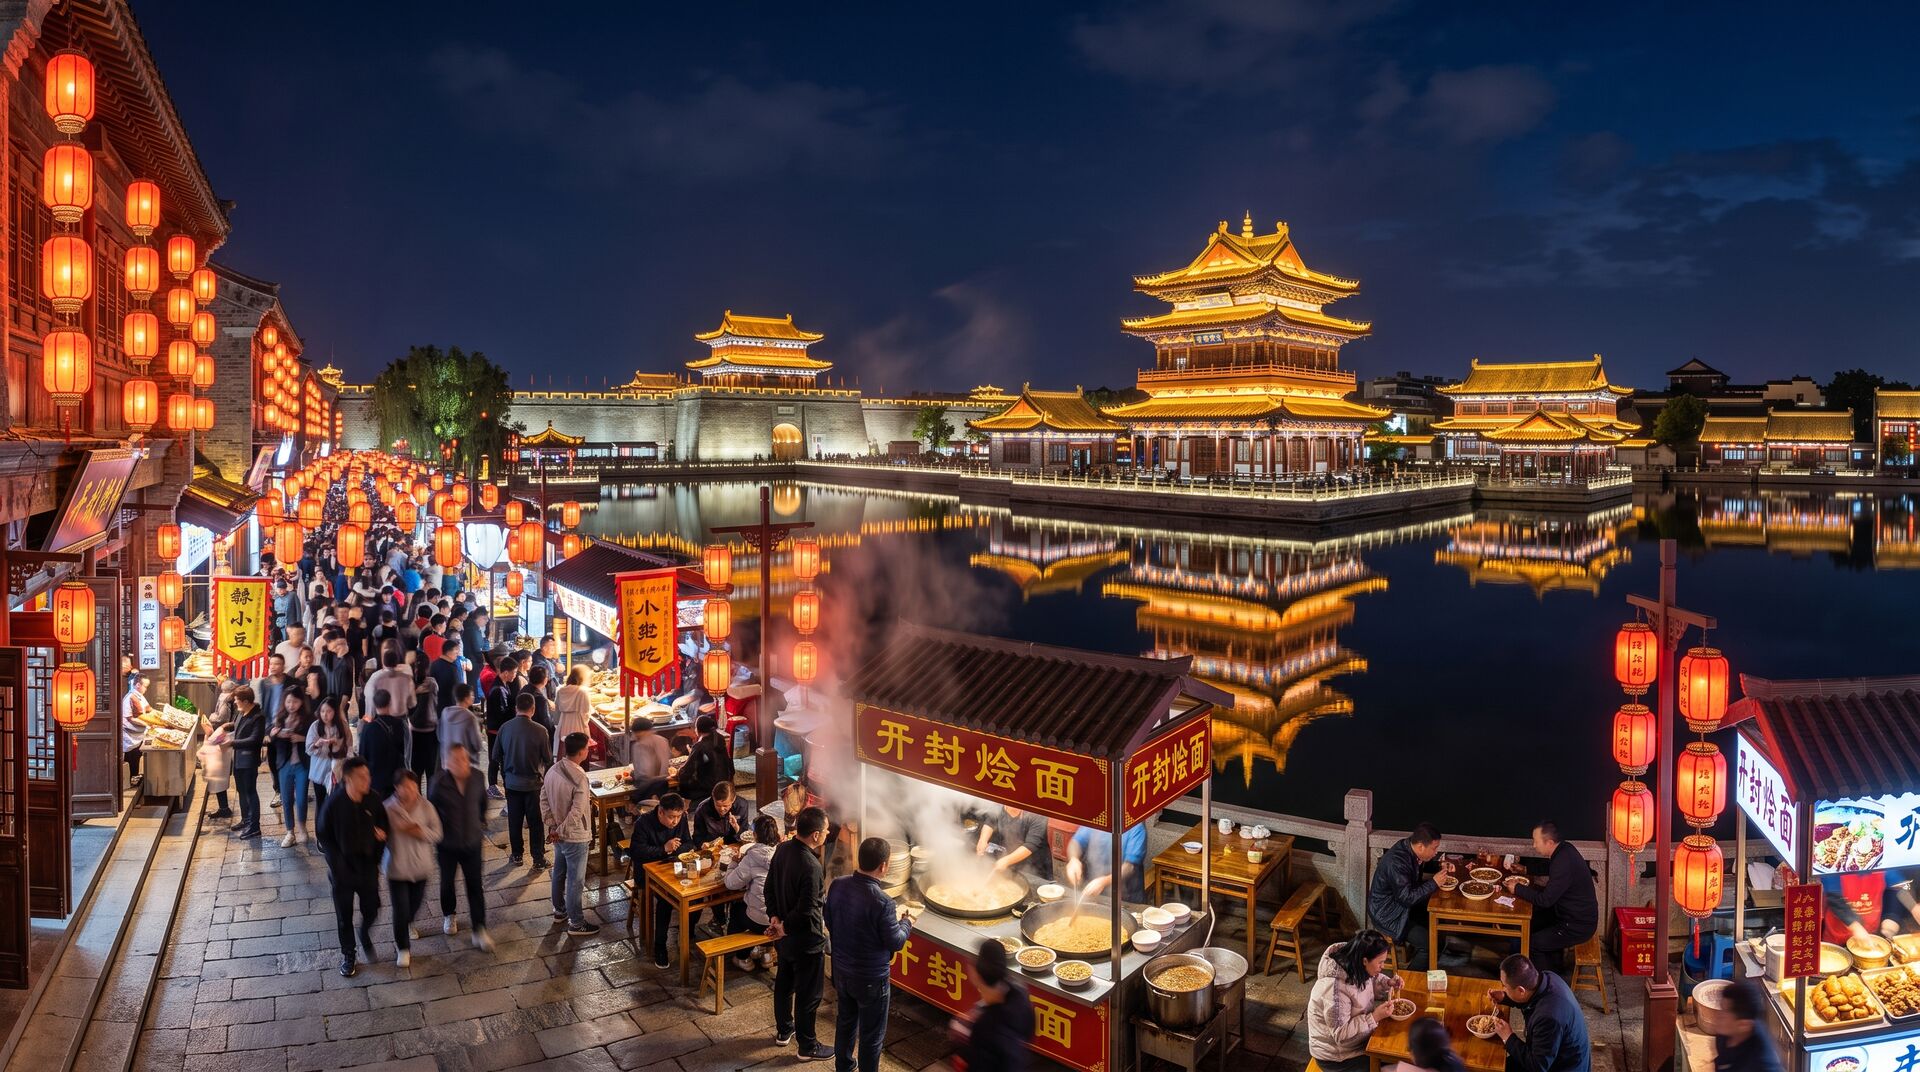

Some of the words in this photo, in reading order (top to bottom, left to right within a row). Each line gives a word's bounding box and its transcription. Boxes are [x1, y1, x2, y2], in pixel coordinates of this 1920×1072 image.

[876, 719, 1079, 806] 开封烩面
[1132, 730, 1205, 807] 开封烩面
[1738, 749, 1792, 852] 开封烩面
[889, 940, 1077, 1049] 开封面
